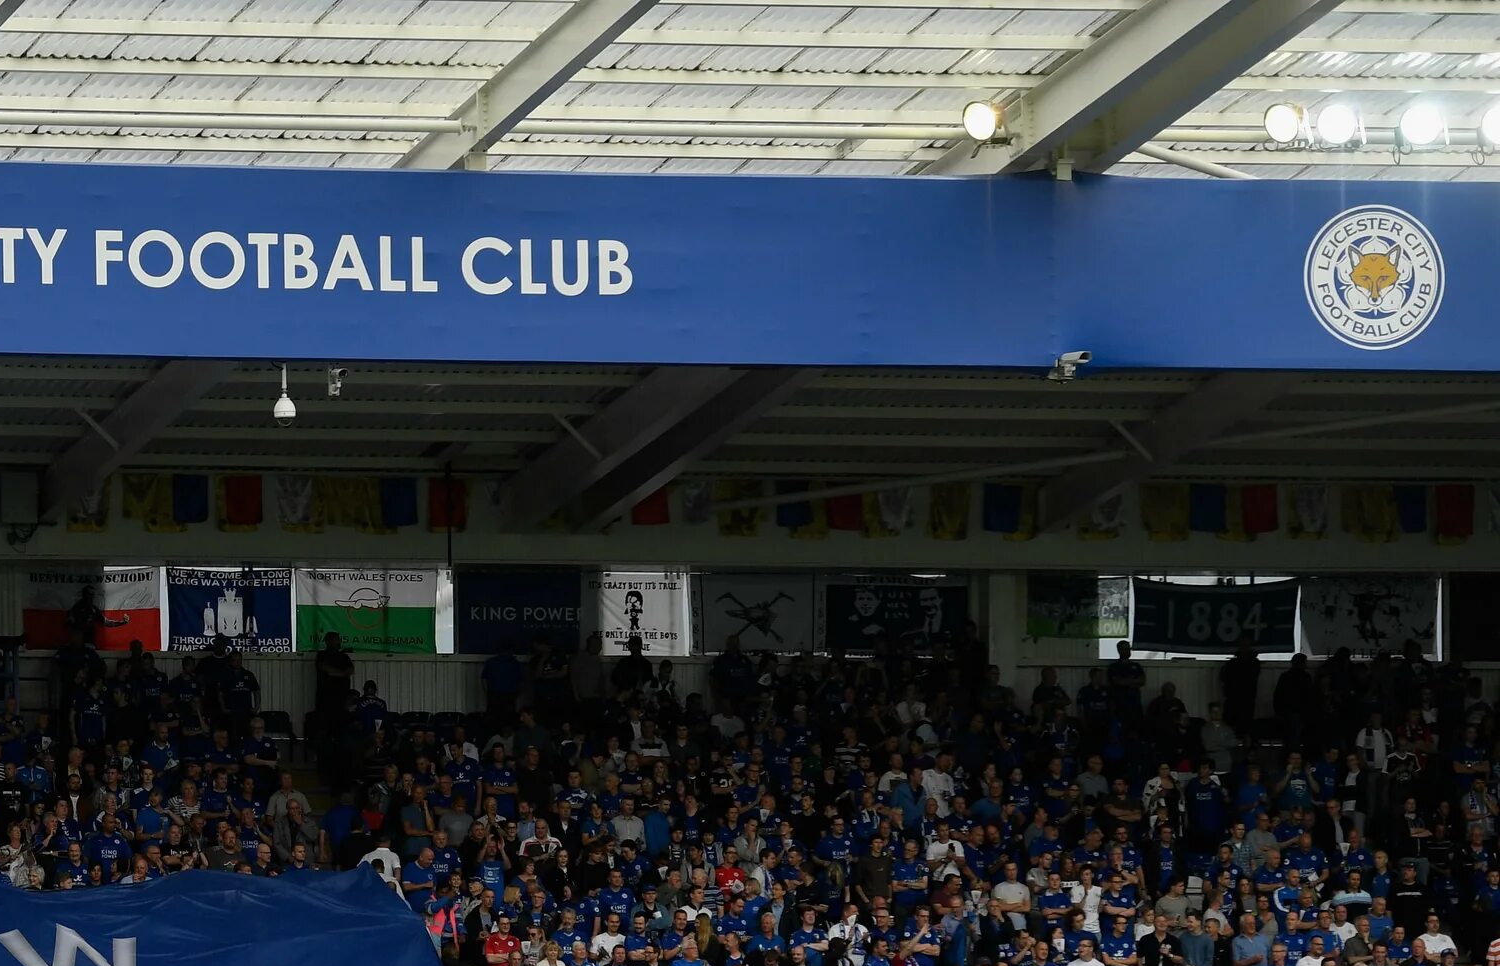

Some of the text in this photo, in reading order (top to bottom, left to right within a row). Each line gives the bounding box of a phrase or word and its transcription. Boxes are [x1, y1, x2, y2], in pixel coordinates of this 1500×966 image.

[1318, 217, 1433, 273] LEICESTER CITY
[95, 229, 438, 293] FOOTBALL
[461, 236, 633, 296] CLUB
[1317, 282, 1432, 338] FOOTBALL CLUB
[169, 569, 206, 578] WE'VE
[210, 571, 243, 580] COME
[260, 570, 291, 579] LONG
[309, 572, 424, 582] NORTH WALES FOXES
[169, 577, 291, 587] LONG WAY TOGETHER
[603, 581, 627, 590] CRAZY
[628, 582, 643, 590] BUT
[470, 606, 517, 621] KING
[1166, 600, 1269, 641] 1884
[644, 631, 658, 640] THE
[660, 631, 678, 640] BOYS
[231, 638, 253, 646] THE
[258, 638, 290, 646] HARD
[259, 645, 291, 653] GOOD
